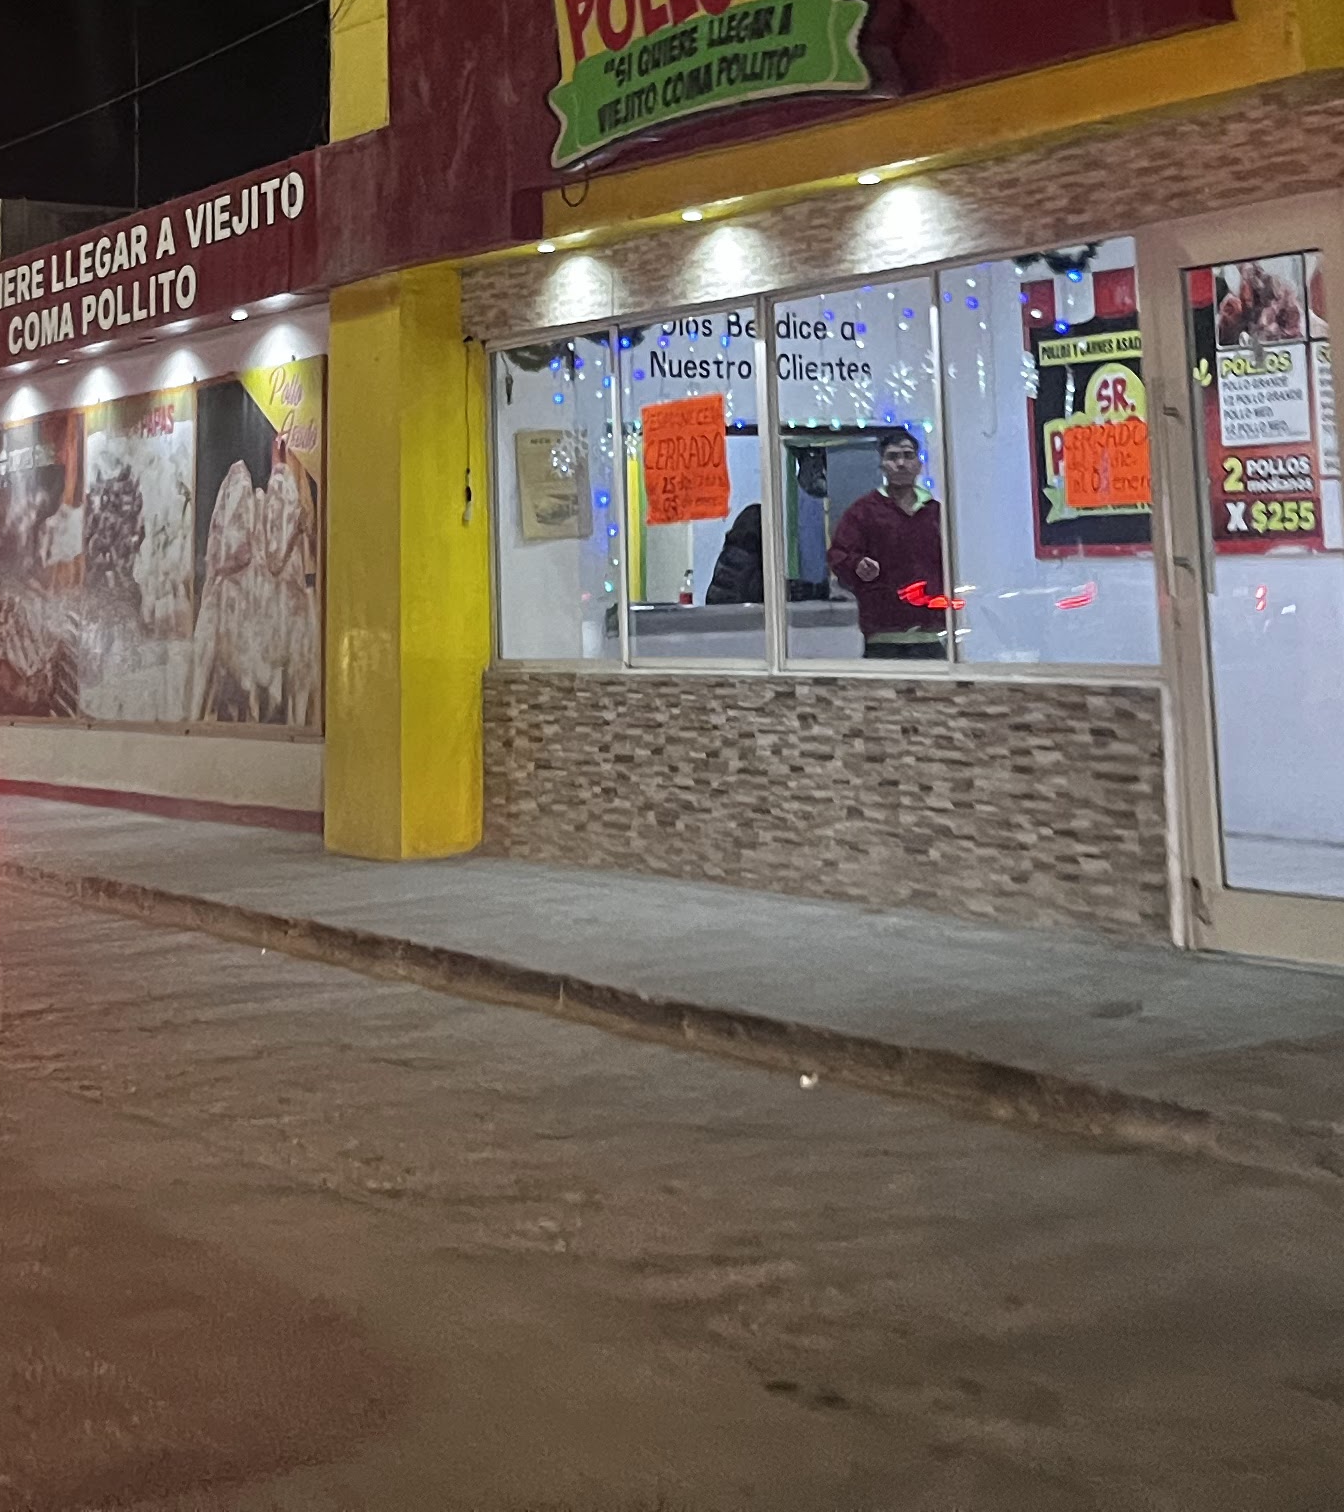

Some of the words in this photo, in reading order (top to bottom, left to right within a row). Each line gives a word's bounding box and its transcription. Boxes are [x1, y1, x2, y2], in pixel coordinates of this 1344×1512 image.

[51, 225, 147, 292] LLEGAR
[156, 216, 175, 259] A
[185, 171, 305, 248] VIEJITO
[8, 301, 75, 356] COMA
[81, 264, 197, 336] POLLITO
[776, 352, 873, 382] Clientes
[644, 431, 723, 471] CERRADO
[1222, 456, 1245, 493] 2
[1225, 501, 1248, 532] X
[1251, 500, 1315, 534] $255
